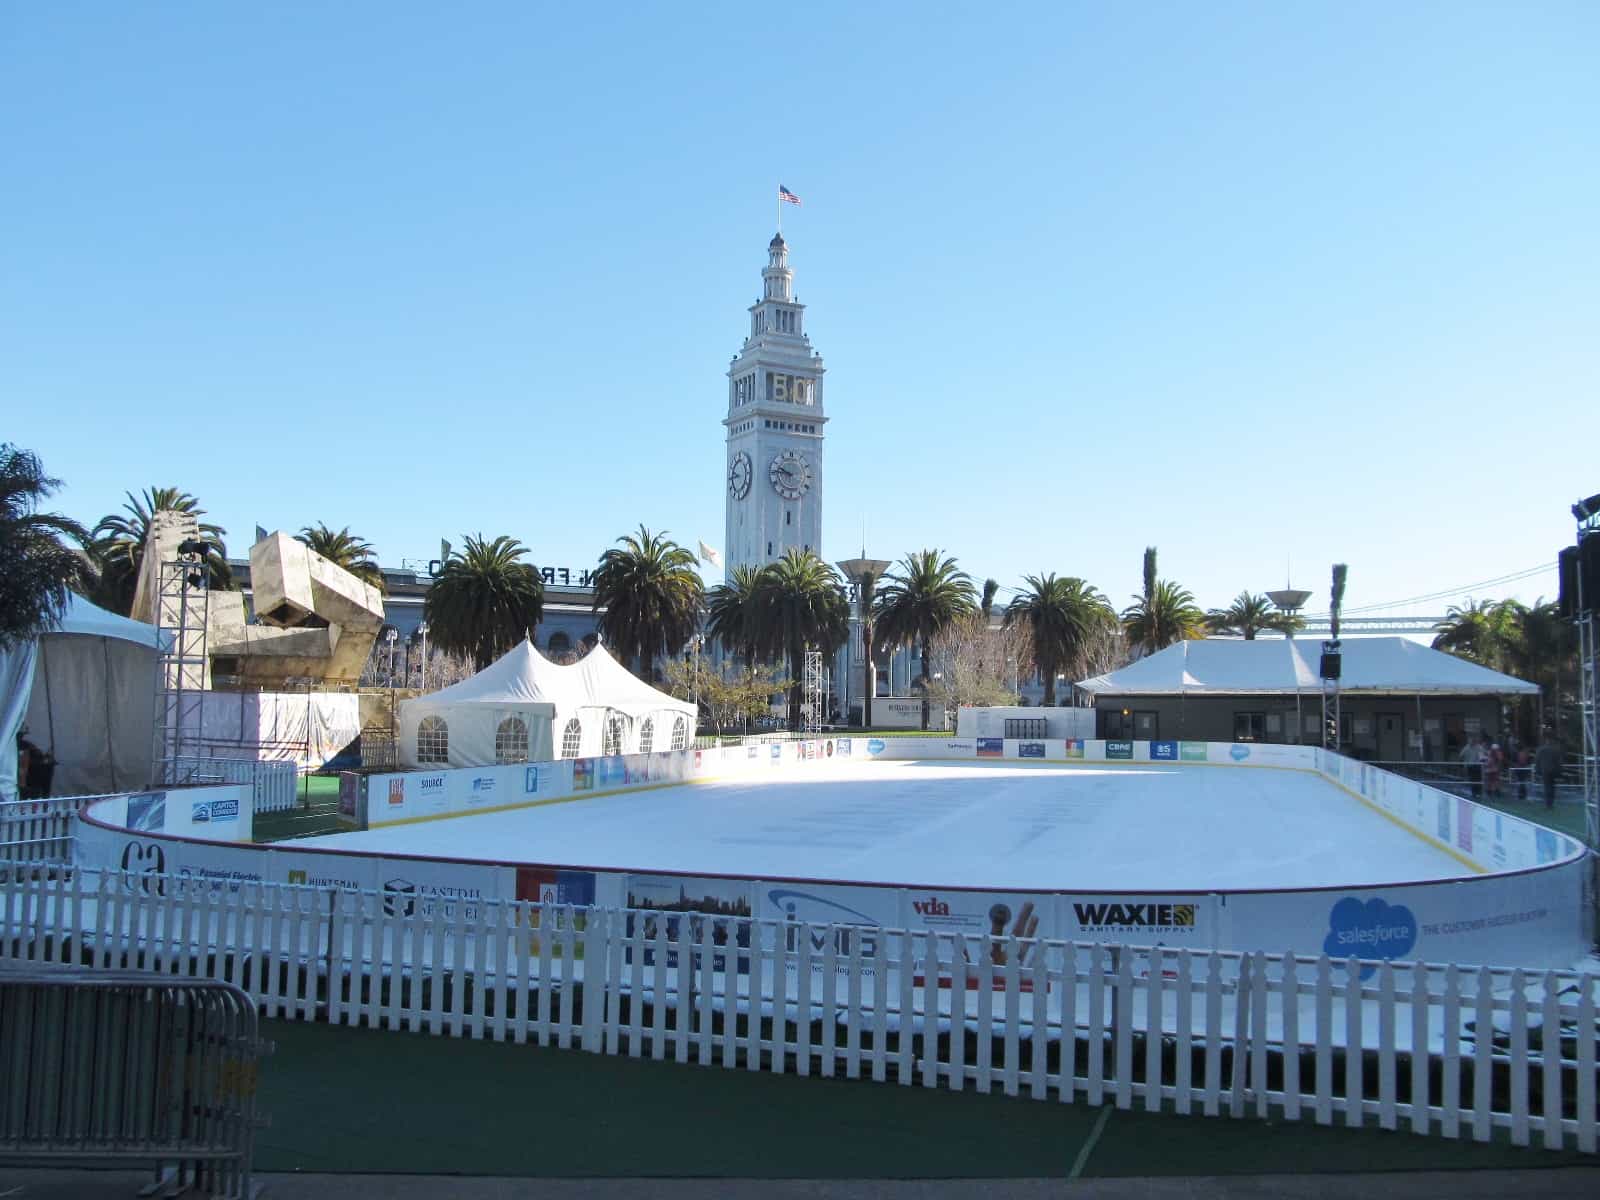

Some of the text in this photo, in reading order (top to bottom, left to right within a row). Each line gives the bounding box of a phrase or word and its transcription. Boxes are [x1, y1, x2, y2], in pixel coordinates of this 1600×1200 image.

[912, 897, 949, 915] vda
[1073, 903, 1172, 925] WAXIE
[1337, 924, 1409, 946] salesforce
[1421, 924, 1440, 936] THE
